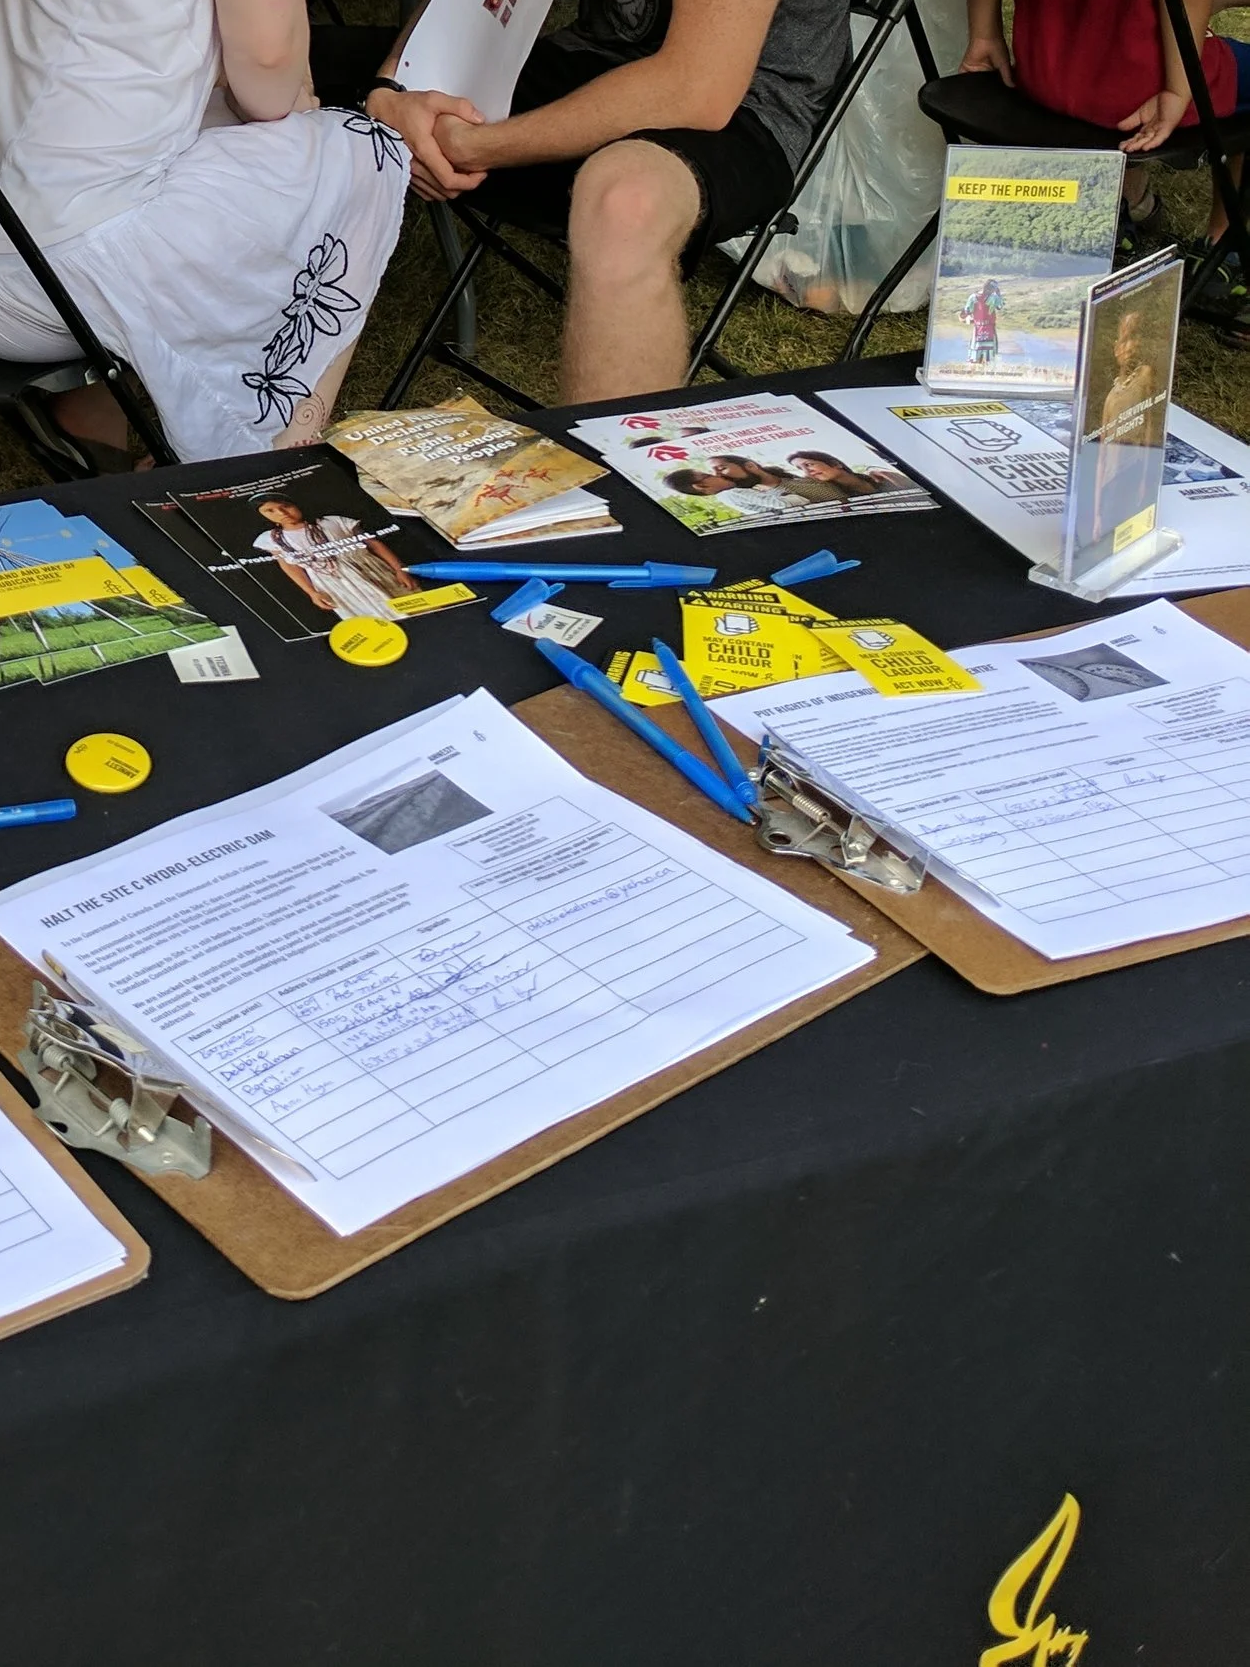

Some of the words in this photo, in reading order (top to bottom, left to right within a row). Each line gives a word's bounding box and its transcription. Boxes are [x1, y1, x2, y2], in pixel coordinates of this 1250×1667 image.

[958, 183, 987, 195] KEEP
[991, 184, 1011, 196] THE
[1015, 186, 1066, 197] PROMISE
[917, 402, 1002, 417] WARNING
[1118, 400, 1153, 424] SURVIVAL
[1154, 390, 1167, 405] and
[345, 419, 405, 441] United
[368, 417, 466, 446] Declaration
[691, 435, 730, 446] FASTER
[731, 424, 783, 439] TIMELINES
[1116, 416, 1145, 437] RIGHTS
[396, 434, 454, 456] Rights
[457, 429, 471, 437] of
[398, 437, 413, 445] on
[416, 431, 434, 439] the
[421, 429, 514, 462] Indigenous
[702, 445, 724, 454] FOR
[725, 435, 769, 451] REFUGEE
[769, 427, 815, 443] FAMILIES
[451, 439, 517, 465] Peoples
[969, 456, 1005, 466] MAY
[1010, 478, 1067, 494] LABO
[1179, 486, 1230, 497] AMNESTY
[308, 532, 376, 553] SURVIVAL
[377, 524, 400, 538] and
[314, 542, 367, 560] RIGHTS
[21, 567, 41, 578] AND
[42, 564, 61, 575] WAY
[62, 563, 75, 571] OF
[38, 572, 62, 582] CREE
[702, 590, 777, 604] WARNING
[708, 600, 783, 615] WARNING
[828, 618, 896, 627] WARNING
[339, 632, 363, 652] AMNESTY
[702, 636, 722, 645] MAY
[724, 638, 775, 649] CONTAIN
[707, 641, 771, 660] CHILD
[707, 653, 773, 669] LABOUR
[870, 655, 934, 669] CHILD
[882, 650, 927, 658] CONTAIN
[880, 665, 945, 678] LABOUR
[753, 708, 774, 718] PUT
[776, 699, 812, 714] RIGHTS
[812, 696, 825, 706] OF
[827, 686, 879, 703] INDIGENOU
[966, 663, 998, 675] ENTRE
[892, 681, 916, 690] ACT
[917, 679, 944, 688] NOW
[427, 745, 455, 762] AMNESTY
[105, 760, 136, 779] AMNESTY
[40, 908, 76, 927] HALT
[73, 897, 103, 914] THE
[100, 885, 133, 903] SITE
[130, 880, 144, 890] C
[142, 838, 247, 886] HYDRO-ELECTRIC
[243, 827, 275, 844] DAM
[81, 919, 120, 938] Government
[126, 905, 153, 918] Canada
[151, 899, 166, 908] and
[188, 1026, 213, 1041] Name
[211, 1012, 241, 1030] (please
[239, 1001, 263, 1016] print)
[277, 980, 307, 996] Address
[336, 957, 360, 970] postal
